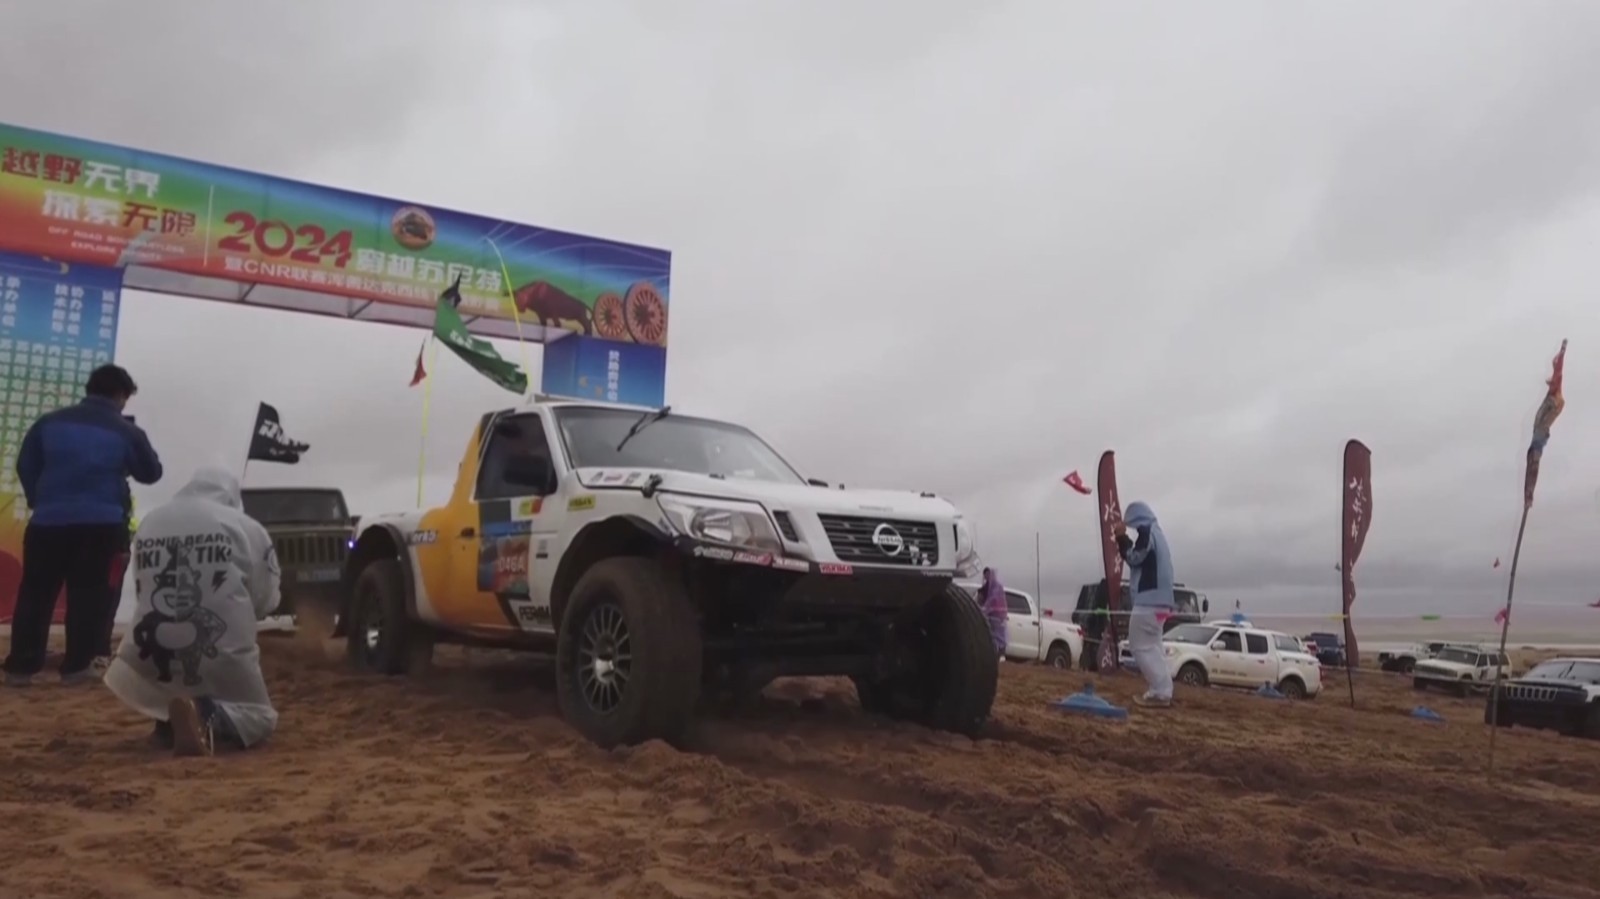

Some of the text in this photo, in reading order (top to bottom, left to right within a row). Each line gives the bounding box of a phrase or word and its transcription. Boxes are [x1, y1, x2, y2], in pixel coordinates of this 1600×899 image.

[2, 147, 160, 198] 越野无界
[218, 211, 352, 268] 2024
